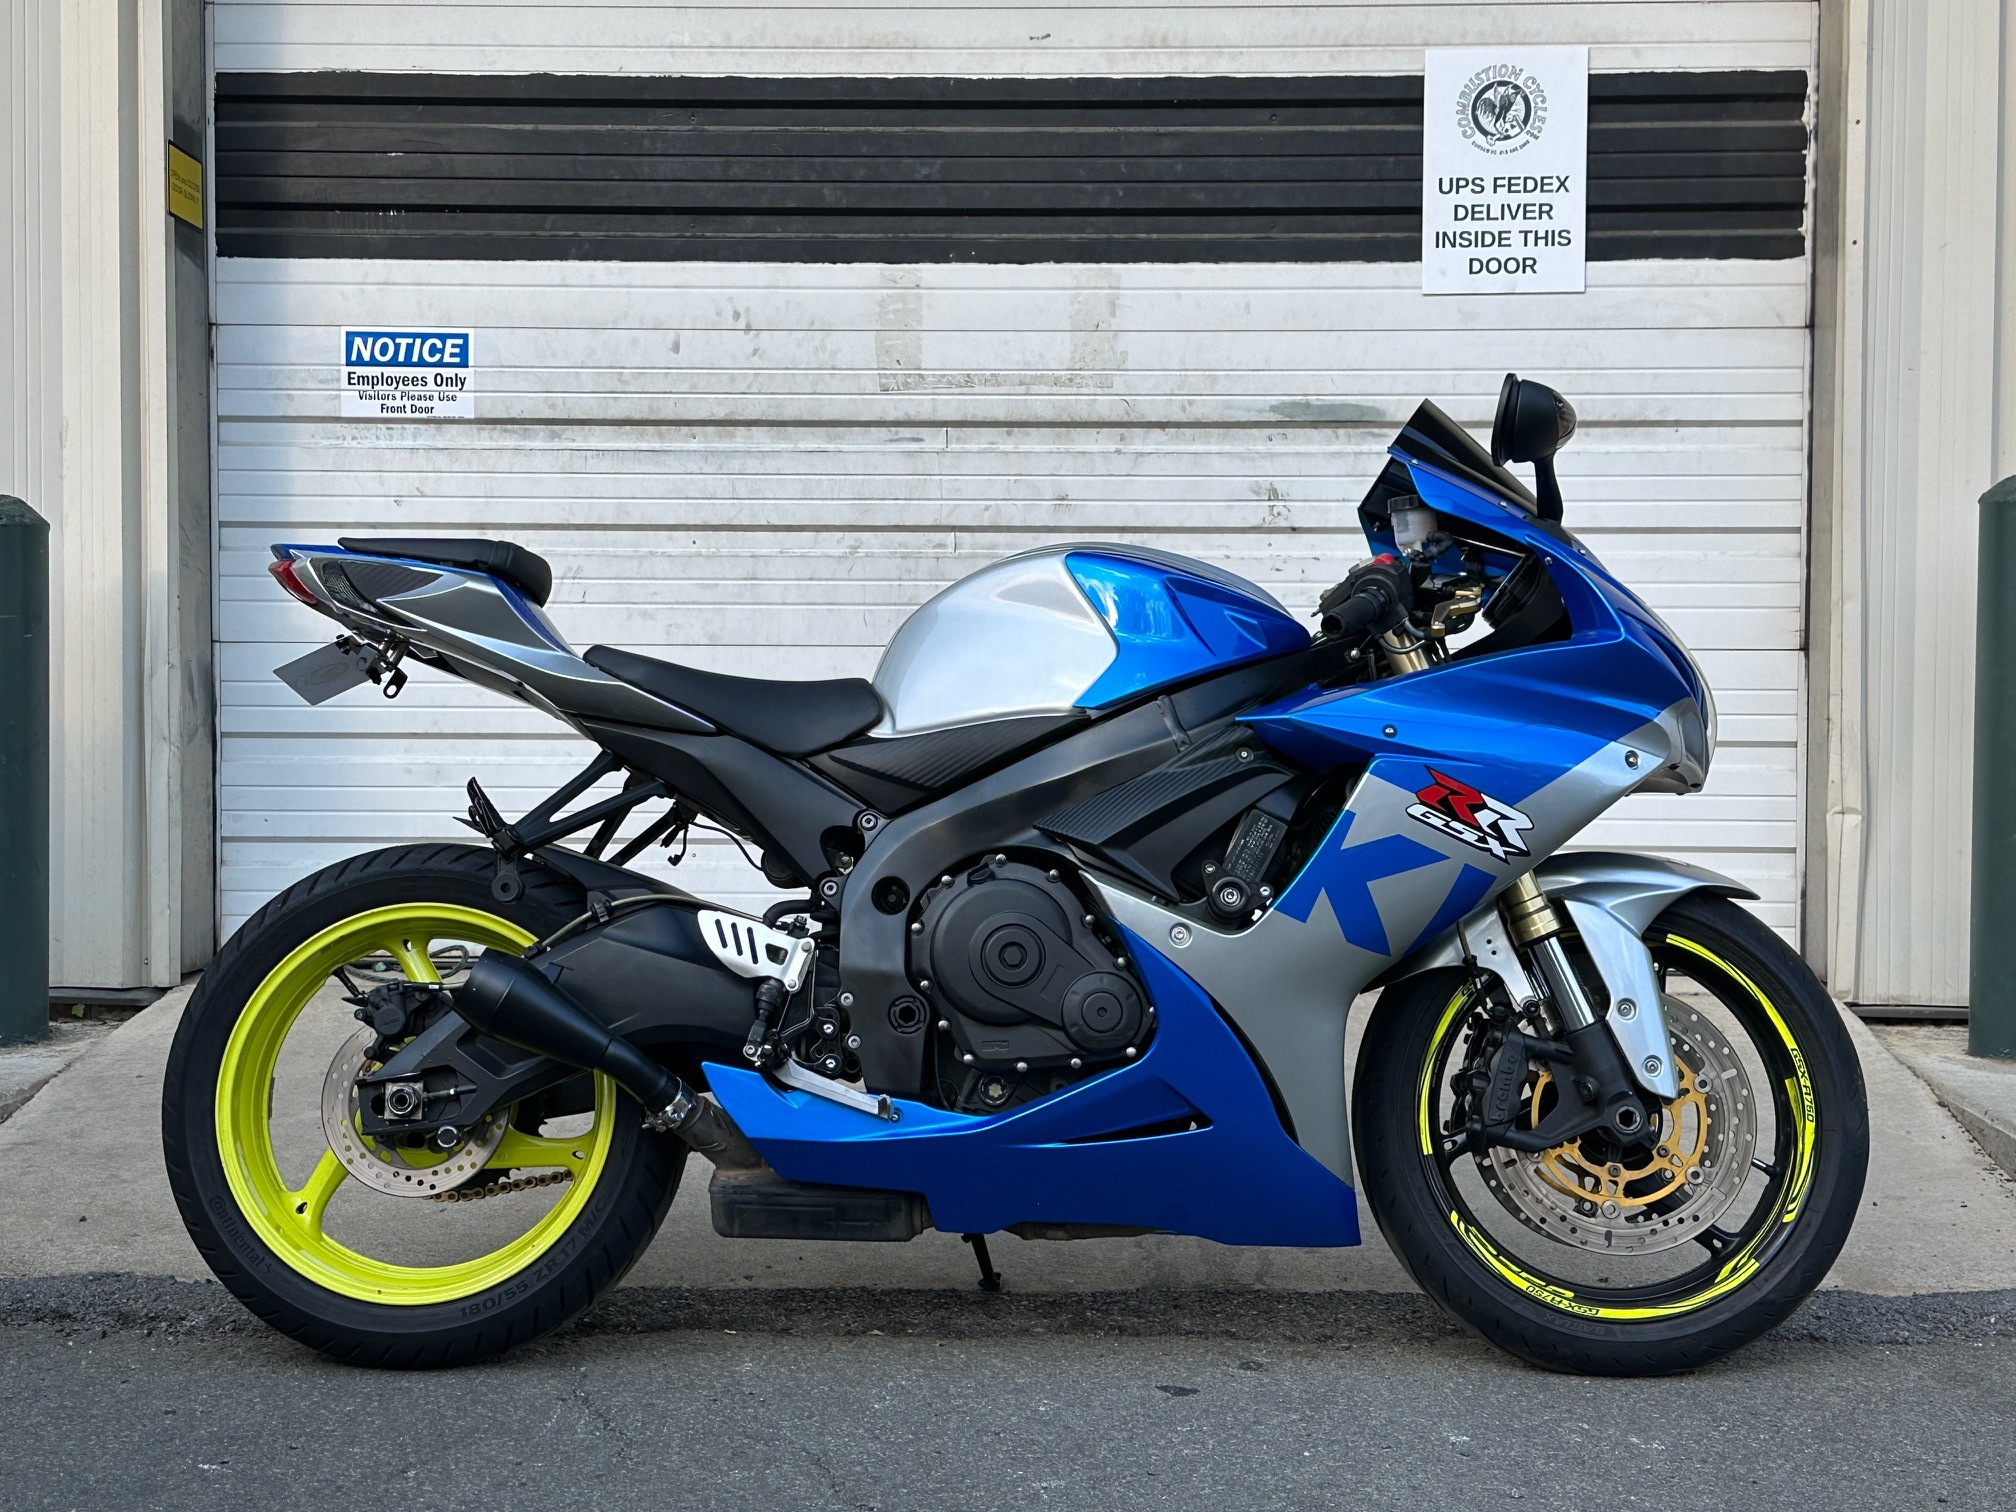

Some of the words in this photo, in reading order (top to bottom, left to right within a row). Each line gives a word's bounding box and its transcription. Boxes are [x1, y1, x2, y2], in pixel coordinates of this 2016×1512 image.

[1456, 64, 1524, 139] COMBUSTION
[1522, 76, 1548, 134] CYCLES
[1438, 177, 1485, 194] UPS
[1493, 175, 1570, 194] FEDEX
[1453, 203, 1553, 221] DELIVER
[1435, 230, 1512, 248] INSIDE
[1518, 229, 1572, 247] THIS
[1468, 257, 1538, 275] DOOR
[351, 336, 463, 363] NOTICE
[347, 371, 428, 390] Employees
[434, 372, 467, 391] Only
[358, 390, 397, 401] Visitors
[400, 391, 434, 402] Please
[438, 391, 457, 402] Use
[380, 403, 407, 414] Front
[410, 404, 434, 415] Door
[459, 1281, 529, 1318] 180/55
[533, 1259, 559, 1282] ZR
